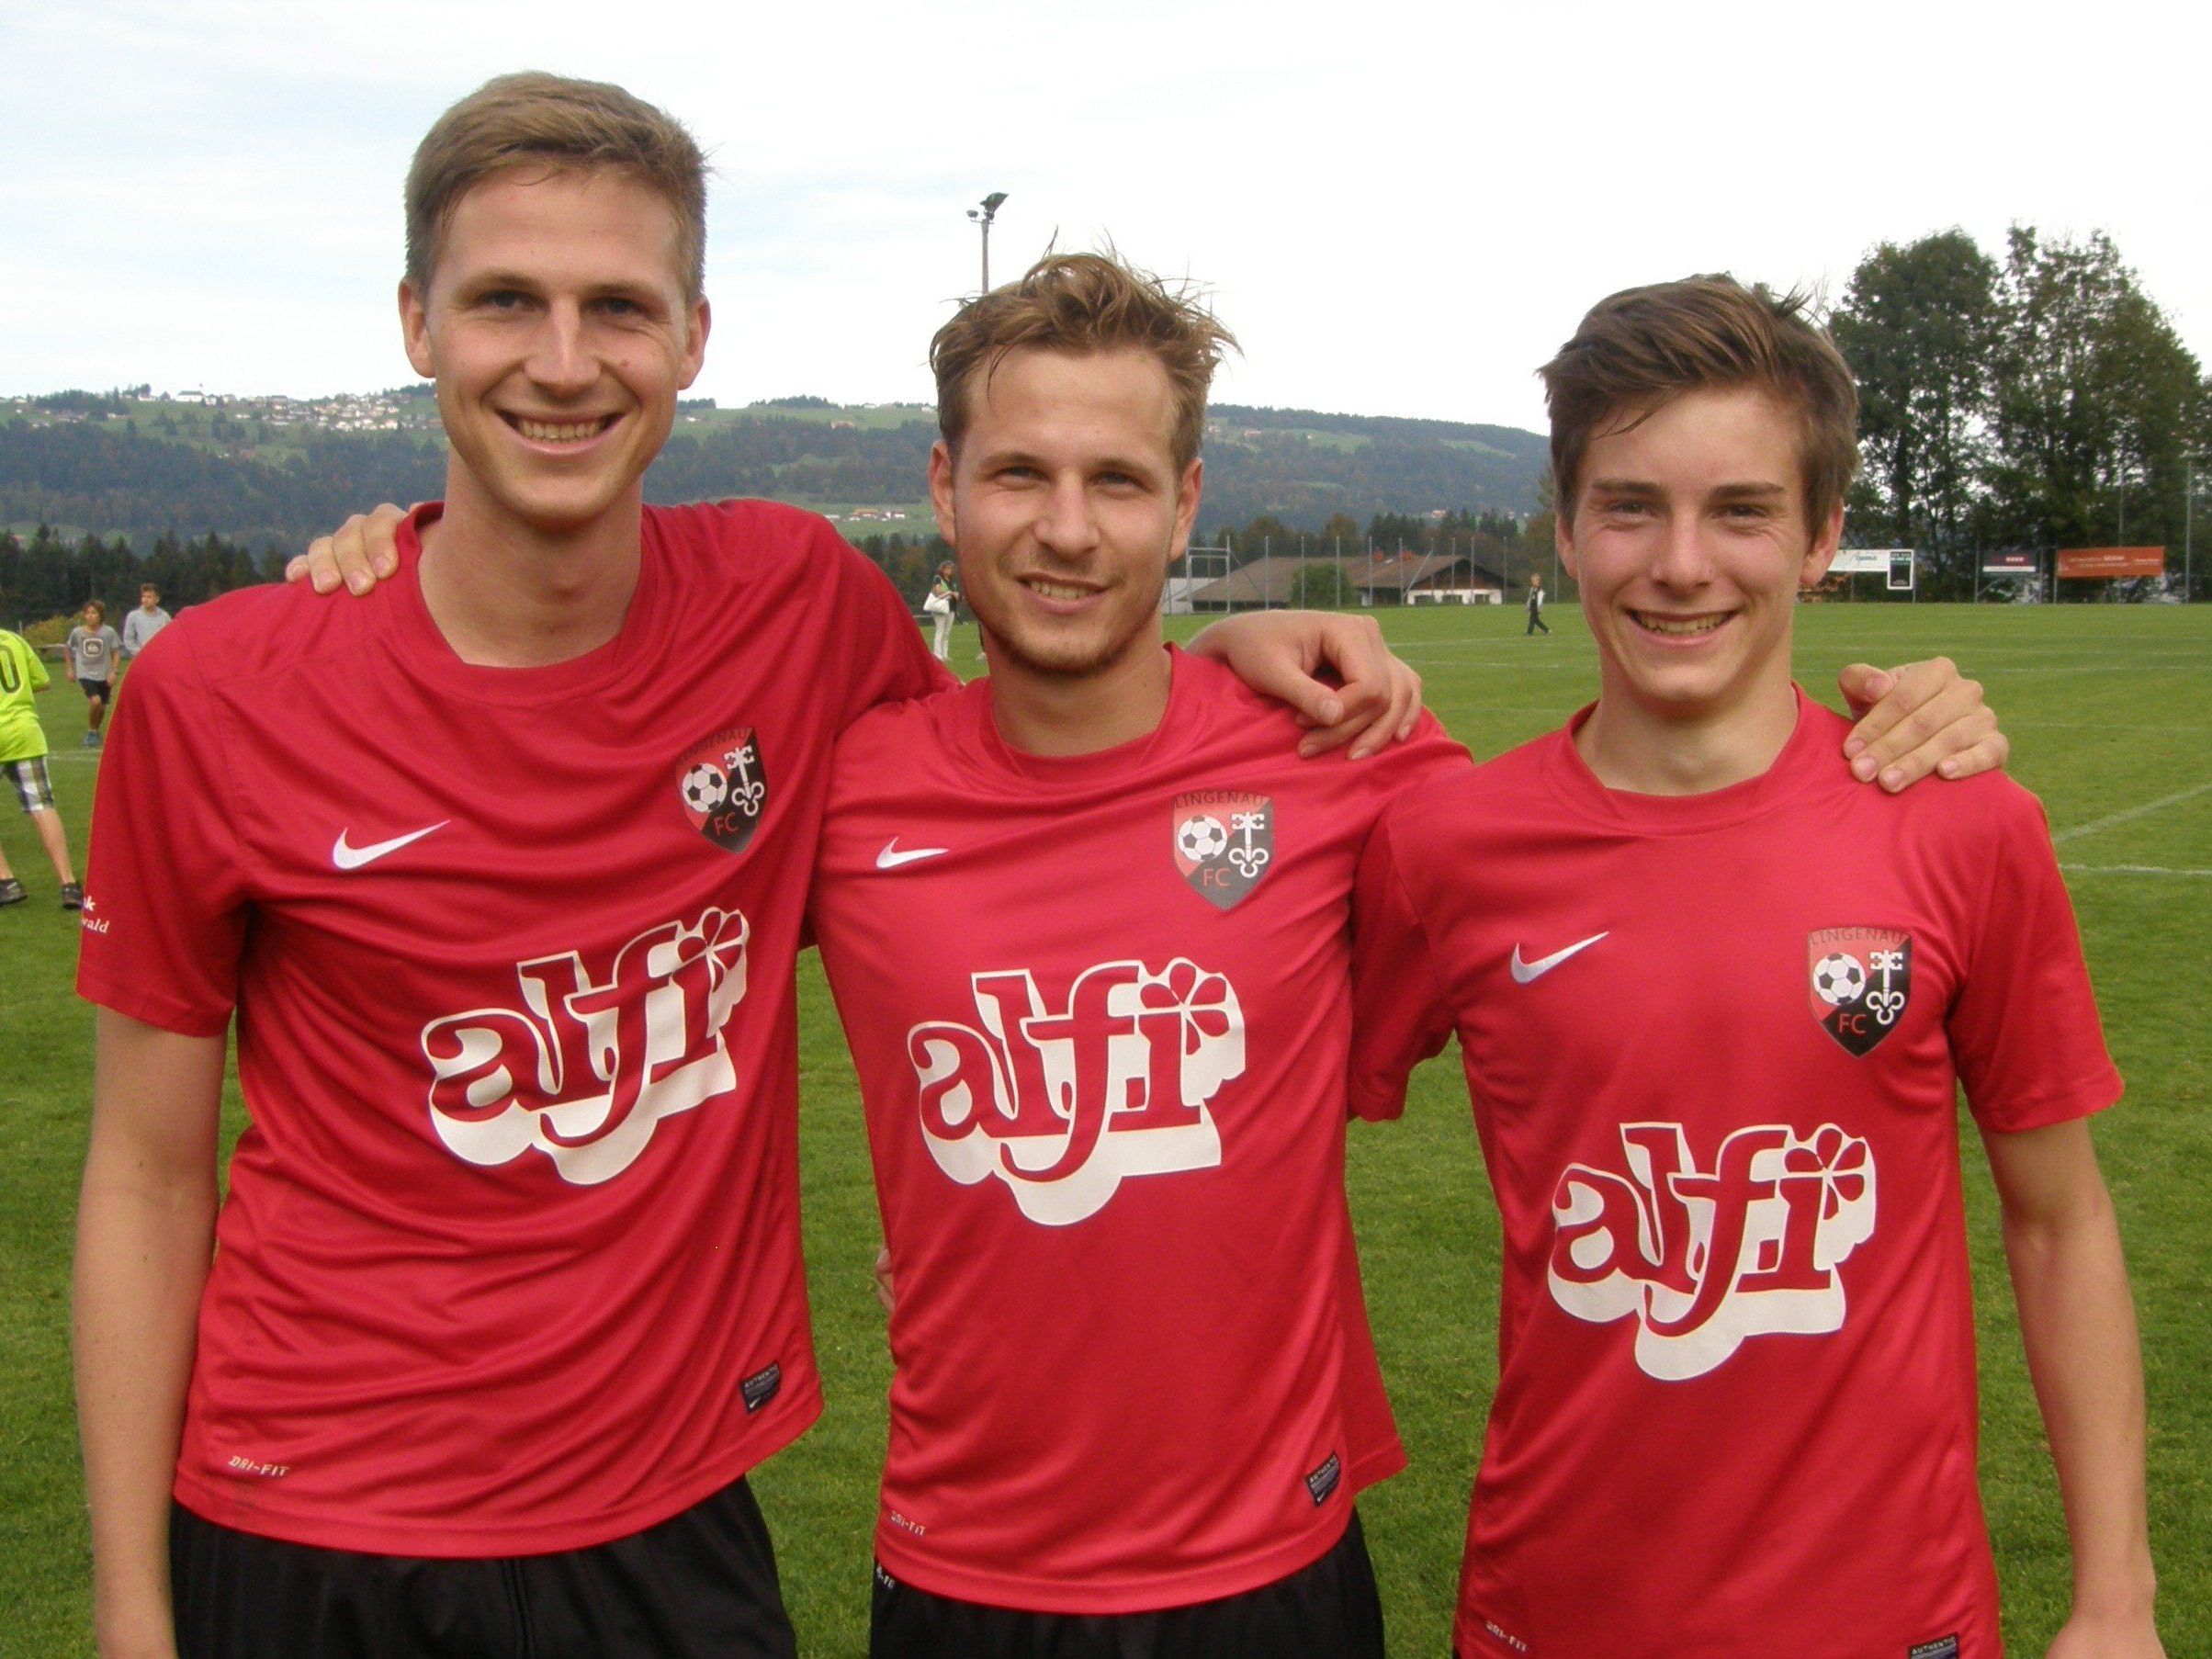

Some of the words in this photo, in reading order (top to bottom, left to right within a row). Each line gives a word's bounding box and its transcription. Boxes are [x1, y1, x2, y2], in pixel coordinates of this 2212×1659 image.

[713, 812, 739, 836] FC
[1202, 868, 1232, 887] FC
[1838, 1013, 1868, 1035] FC
[421, 906, 750, 1185] alfi
[907, 956, 1247, 1227] alfi
[1547, 1122, 1877, 1382] alfi
[228, 1455, 290, 1476] DRI-FIT
